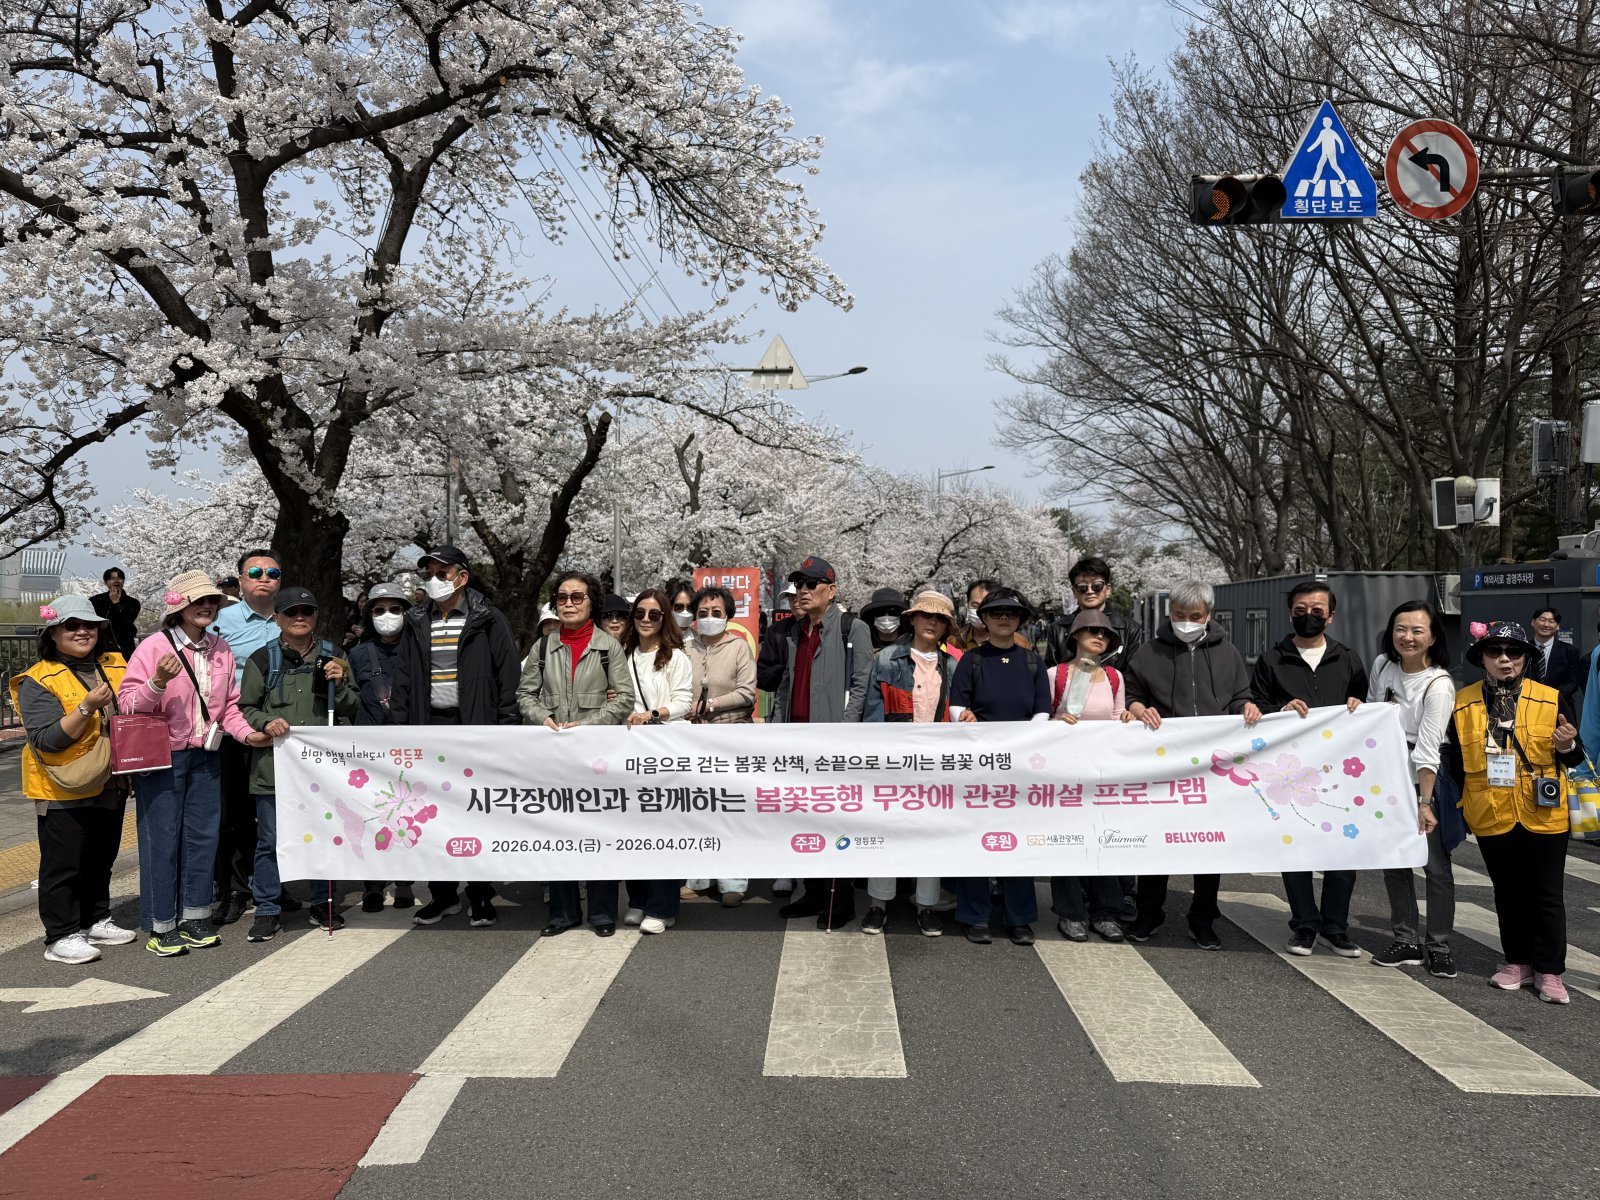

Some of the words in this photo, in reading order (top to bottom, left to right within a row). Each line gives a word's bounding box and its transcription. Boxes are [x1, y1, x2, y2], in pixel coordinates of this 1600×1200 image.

[1294, 199, 1363, 214] 횡단보도
[721, 576, 750, 590] 맞다
[1506, 573, 1534, 585] 공영주차장
[301, 746, 323, 763] 희망
[325, 748, 346, 766] 행복
[346, 741, 385, 760] 미래도시
[389, 748, 423, 768] 영등포
[625, 756, 692, 775] 마음으로
[696, 756, 730, 774] 걷는
[734, 756, 768, 773] 봄꽃
[771, 755, 810, 774] 산책,
[813, 754, 881, 773] 손끝으로
[885, 754, 936, 772] 느끼는
[939, 753, 974, 771] 봄꽃
[978, 753, 1012, 771] 여행
[466, 787, 630, 814] 시각장애인과
[636, 787, 746, 813] 함께하는
[755, 784, 863, 813] 봄꽃동행
[872, 783, 954, 811] 무장애
[962, 783, 1020, 808] 관광
[1026, 783, 1083, 808] 해설
[1092, 776, 1208, 806] 프로그램
[794, 836, 821, 851] 주관
[854, 836, 885, 846] 영등포구
[985, 834, 1012, 849] 후원
[1046, 835, 1085, 843] 서울관광재단
[1098, 829, 1149, 845] Fairmont
[1165, 831, 1225, 844] BELLYGOM
[450, 839, 478, 855] 일자
[491, 838, 602, 854] 2026.04.03.(금)
[615, 837, 722, 853] 2026.04.07.(화)
